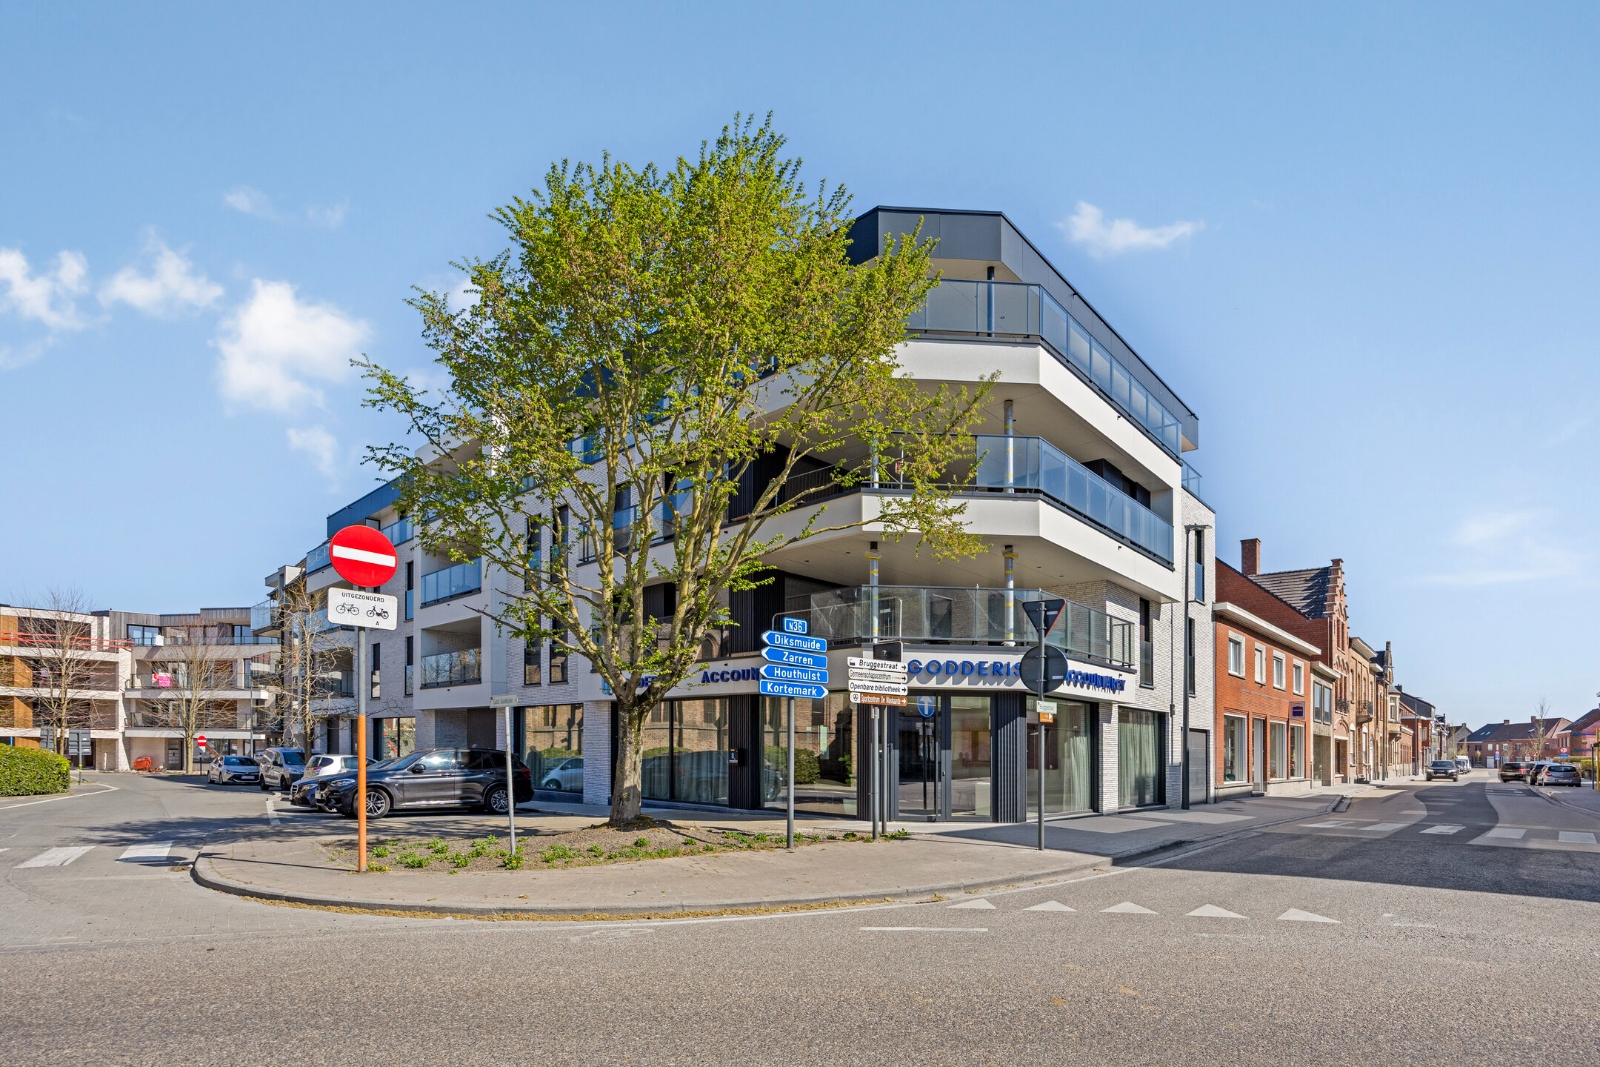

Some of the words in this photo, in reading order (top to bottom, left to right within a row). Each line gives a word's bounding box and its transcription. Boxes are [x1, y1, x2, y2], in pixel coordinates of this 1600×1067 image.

[341, 592, 385, 602] UITGEZONDERD
[789, 621, 803, 632] N36
[774, 634, 821, 649] Diksmuide
[783, 651, 813, 665] Zarren
[859, 659, 898, 670] Bruggestraat
[701, 666, 760, 684] ACCOUN
[774, 667, 821, 681] Houthulst
[907, 659, 1021, 677] GODDERIS
[767, 682, 817, 696] Kortemark
[850, 682, 874, 691] Openbare
[875, 685, 901, 693] bibliotheek
